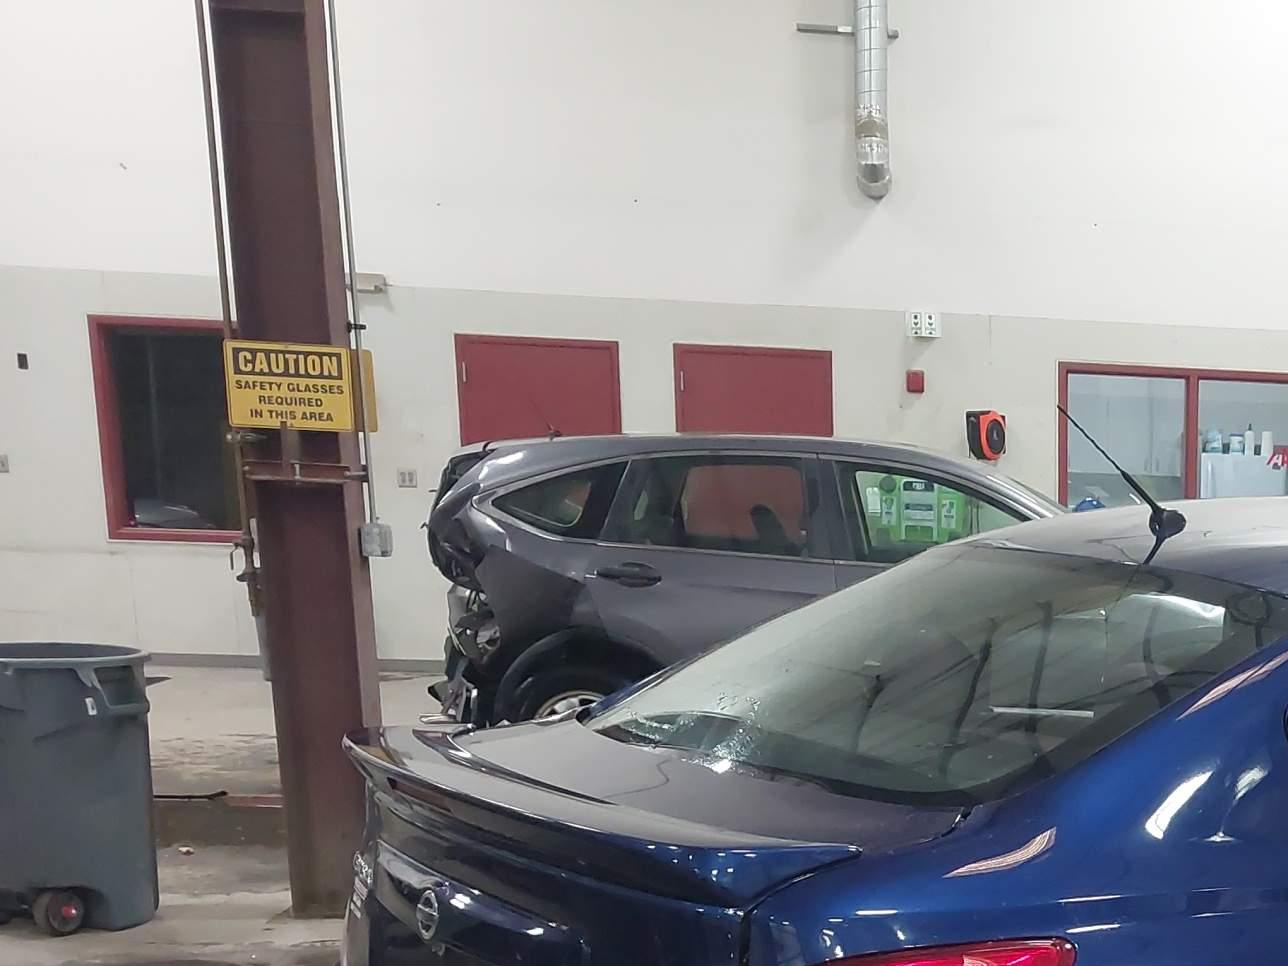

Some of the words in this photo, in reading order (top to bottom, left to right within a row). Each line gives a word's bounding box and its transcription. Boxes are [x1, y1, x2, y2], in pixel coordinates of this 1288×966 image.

[238, 350, 338, 377] CAUTION
[234, 379, 282, 391] SAFETY
[287, 382, 344, 395] GLASSES
[258, 395, 323, 408] REQUIRED
[250, 409, 263, 419] IN
[267, 409, 297, 420] THIS
[300, 411, 334, 422] AREA
